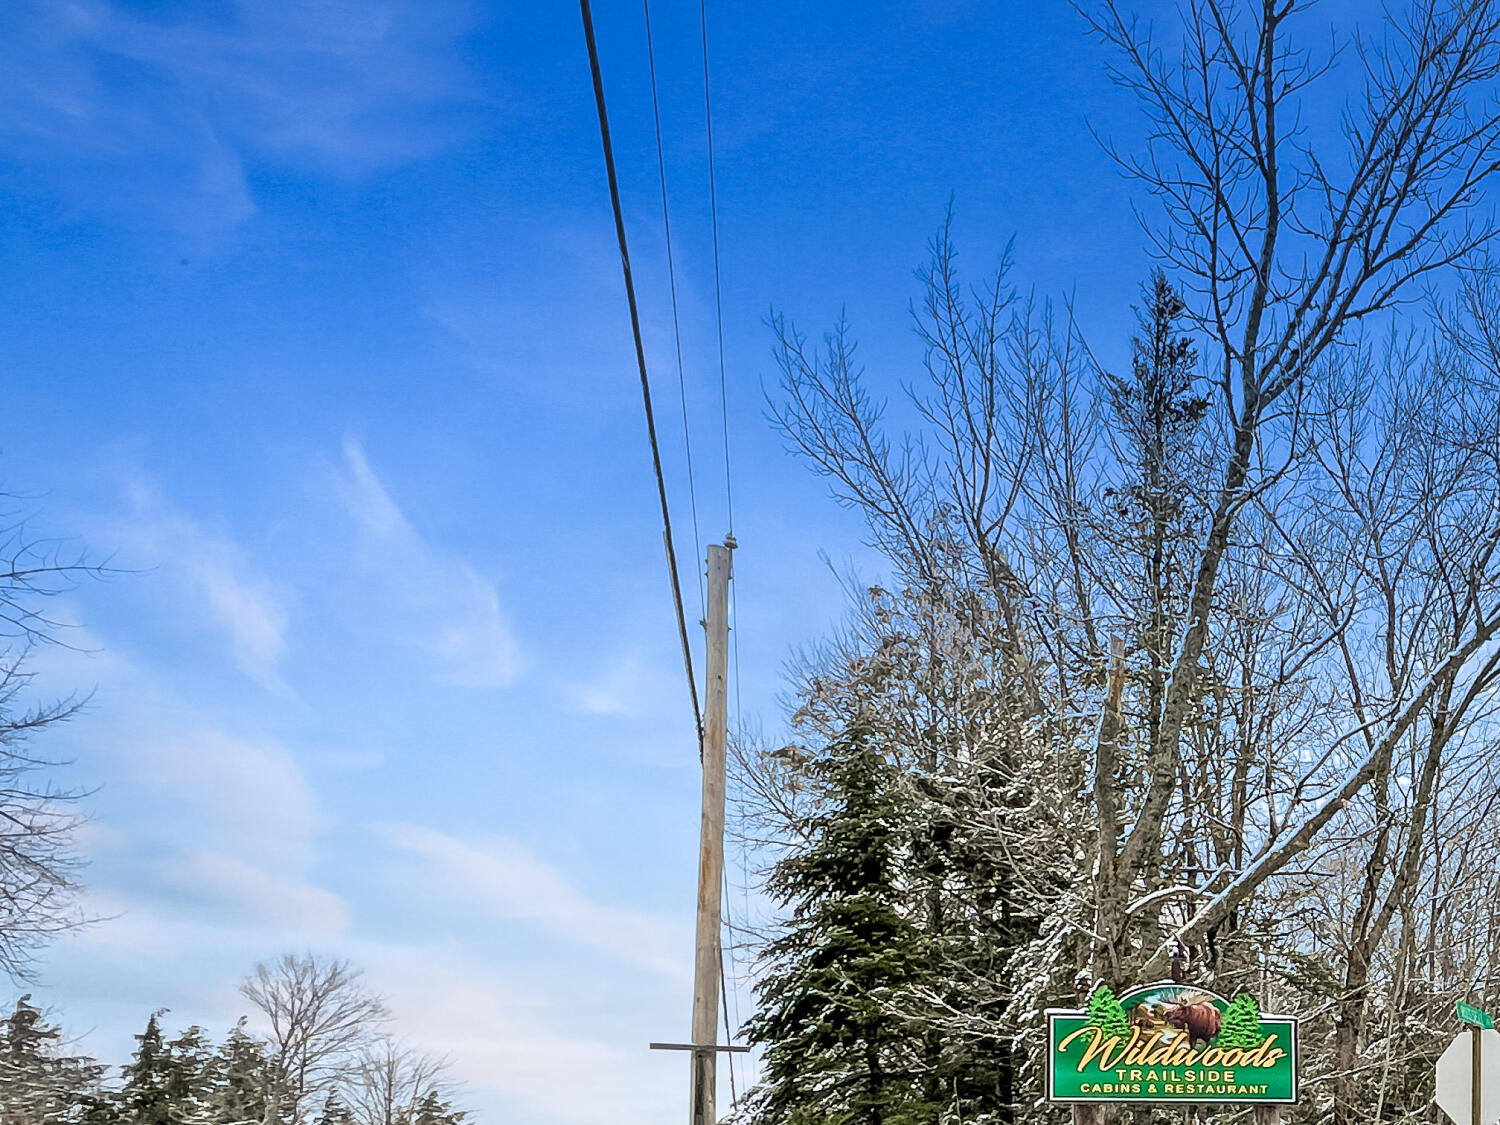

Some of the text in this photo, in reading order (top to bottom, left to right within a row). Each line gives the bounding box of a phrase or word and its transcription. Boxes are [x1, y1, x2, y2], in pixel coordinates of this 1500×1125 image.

[1058, 1026, 1287, 1072] Wildwoods
[1115, 1069, 1236, 1083] TRAILSIDE
[1080, 1083, 1269, 1095] CABINS & RESTAURANT
